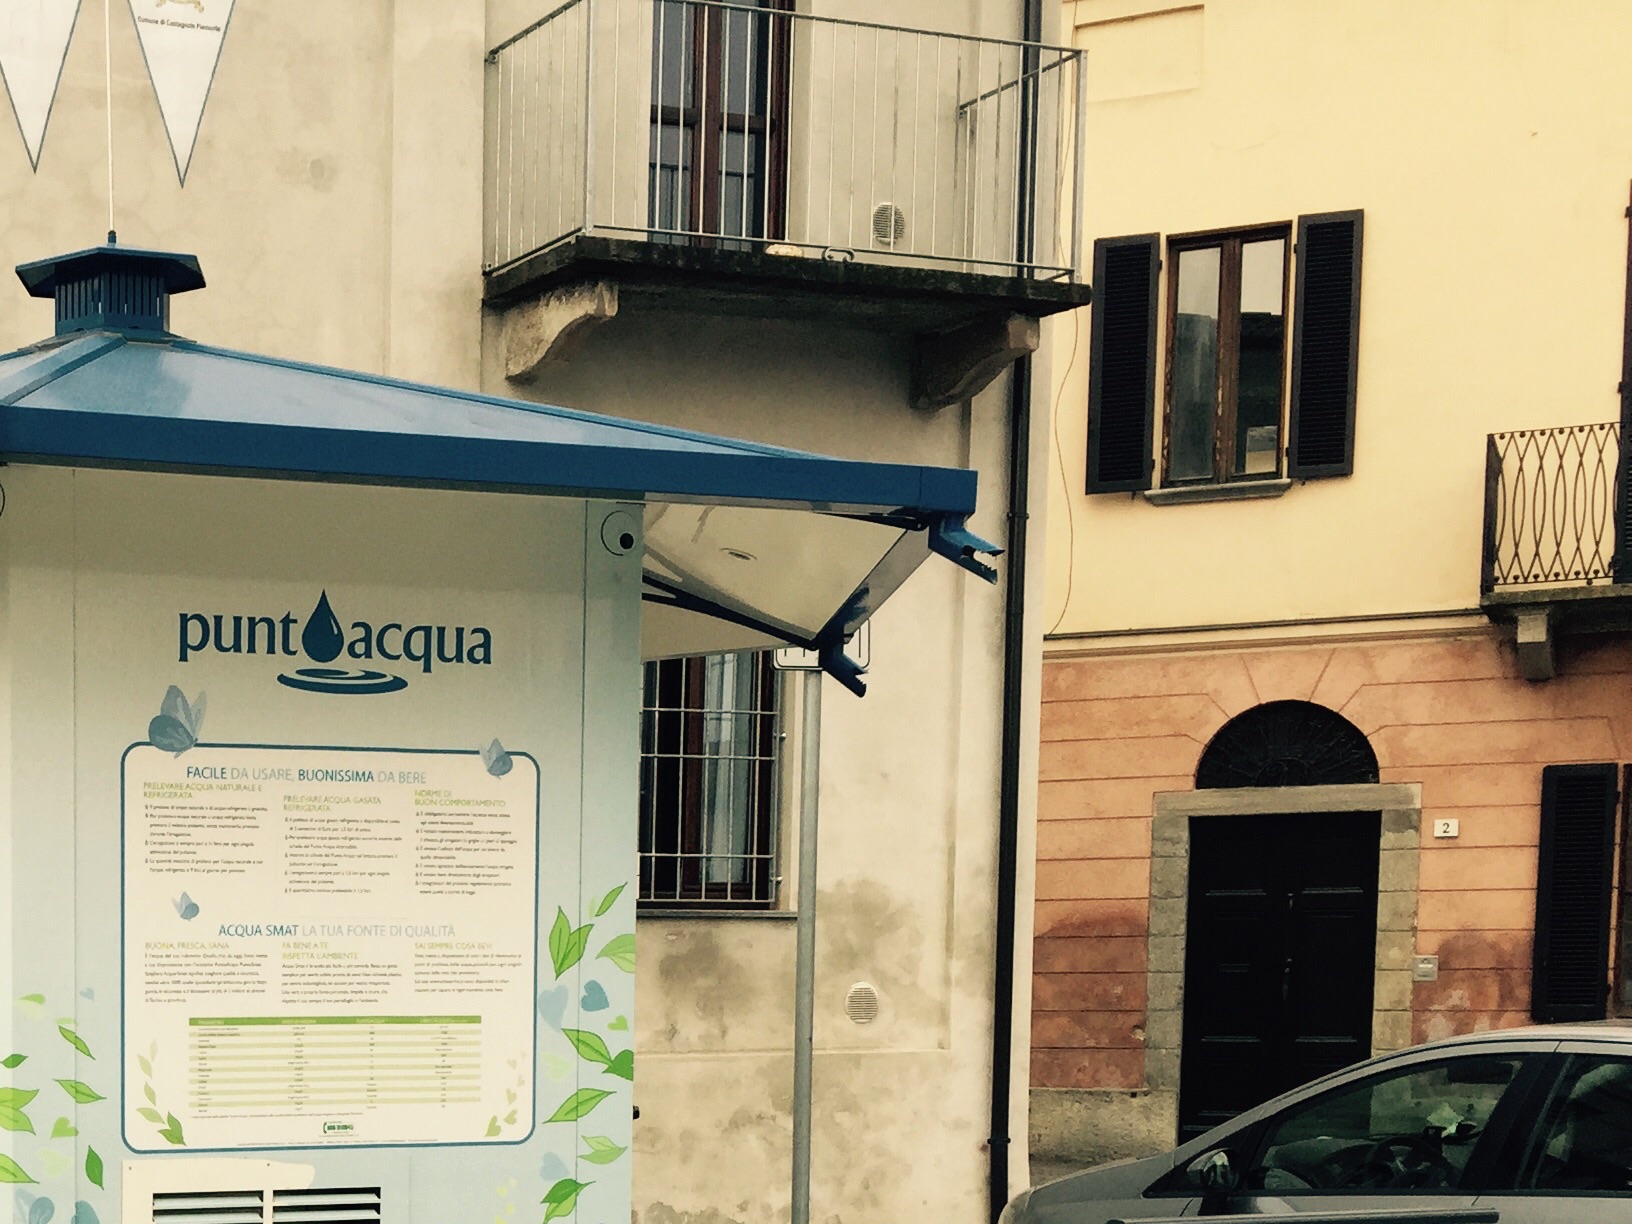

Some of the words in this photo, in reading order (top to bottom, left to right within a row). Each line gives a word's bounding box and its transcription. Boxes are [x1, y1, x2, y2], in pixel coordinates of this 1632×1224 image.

[346, 618, 493, 673] acqua
[186, 766, 228, 780] FACILE
[231, 767, 249, 780] DA
[252, 767, 295, 782] USARE,
[298, 768, 374, 782] BUONISSIMA
[377, 771, 395, 782] DA
[398, 771, 427, 784] BERE
[143, 782, 184, 791] PRELEVARE
[185, 783, 214, 792] ACQUA
[216, 784, 256, 792] NATURALE
[143, 791, 193, 799] REFRIGERATA
[414, 789, 442, 798] NORME
[283, 795, 323, 804] PRELEVARE
[324, 796, 351, 804] ACQUA
[352, 796, 381, 804] GASATA
[414, 798, 438, 806] BUON
[439, 799, 506, 807] COMPORTAMENTO
[283, 804, 331, 812] REFRIGERATA
[1442, 822, 1450, 834] 2
[218, 924, 262, 938] ACQUA
[265, 924, 299, 937] SMAT
[302, 924, 317, 937] LA
[320, 924, 344, 937] TUA
[347, 924, 387, 937] FONTE
[389, 924, 402, 937] DI
[405, 923, 456, 938] QUALITÀ
[208, 942, 230, 950] SANA
[293, 941, 312, 950] BENE
[455, 942, 476, 950] COSA
